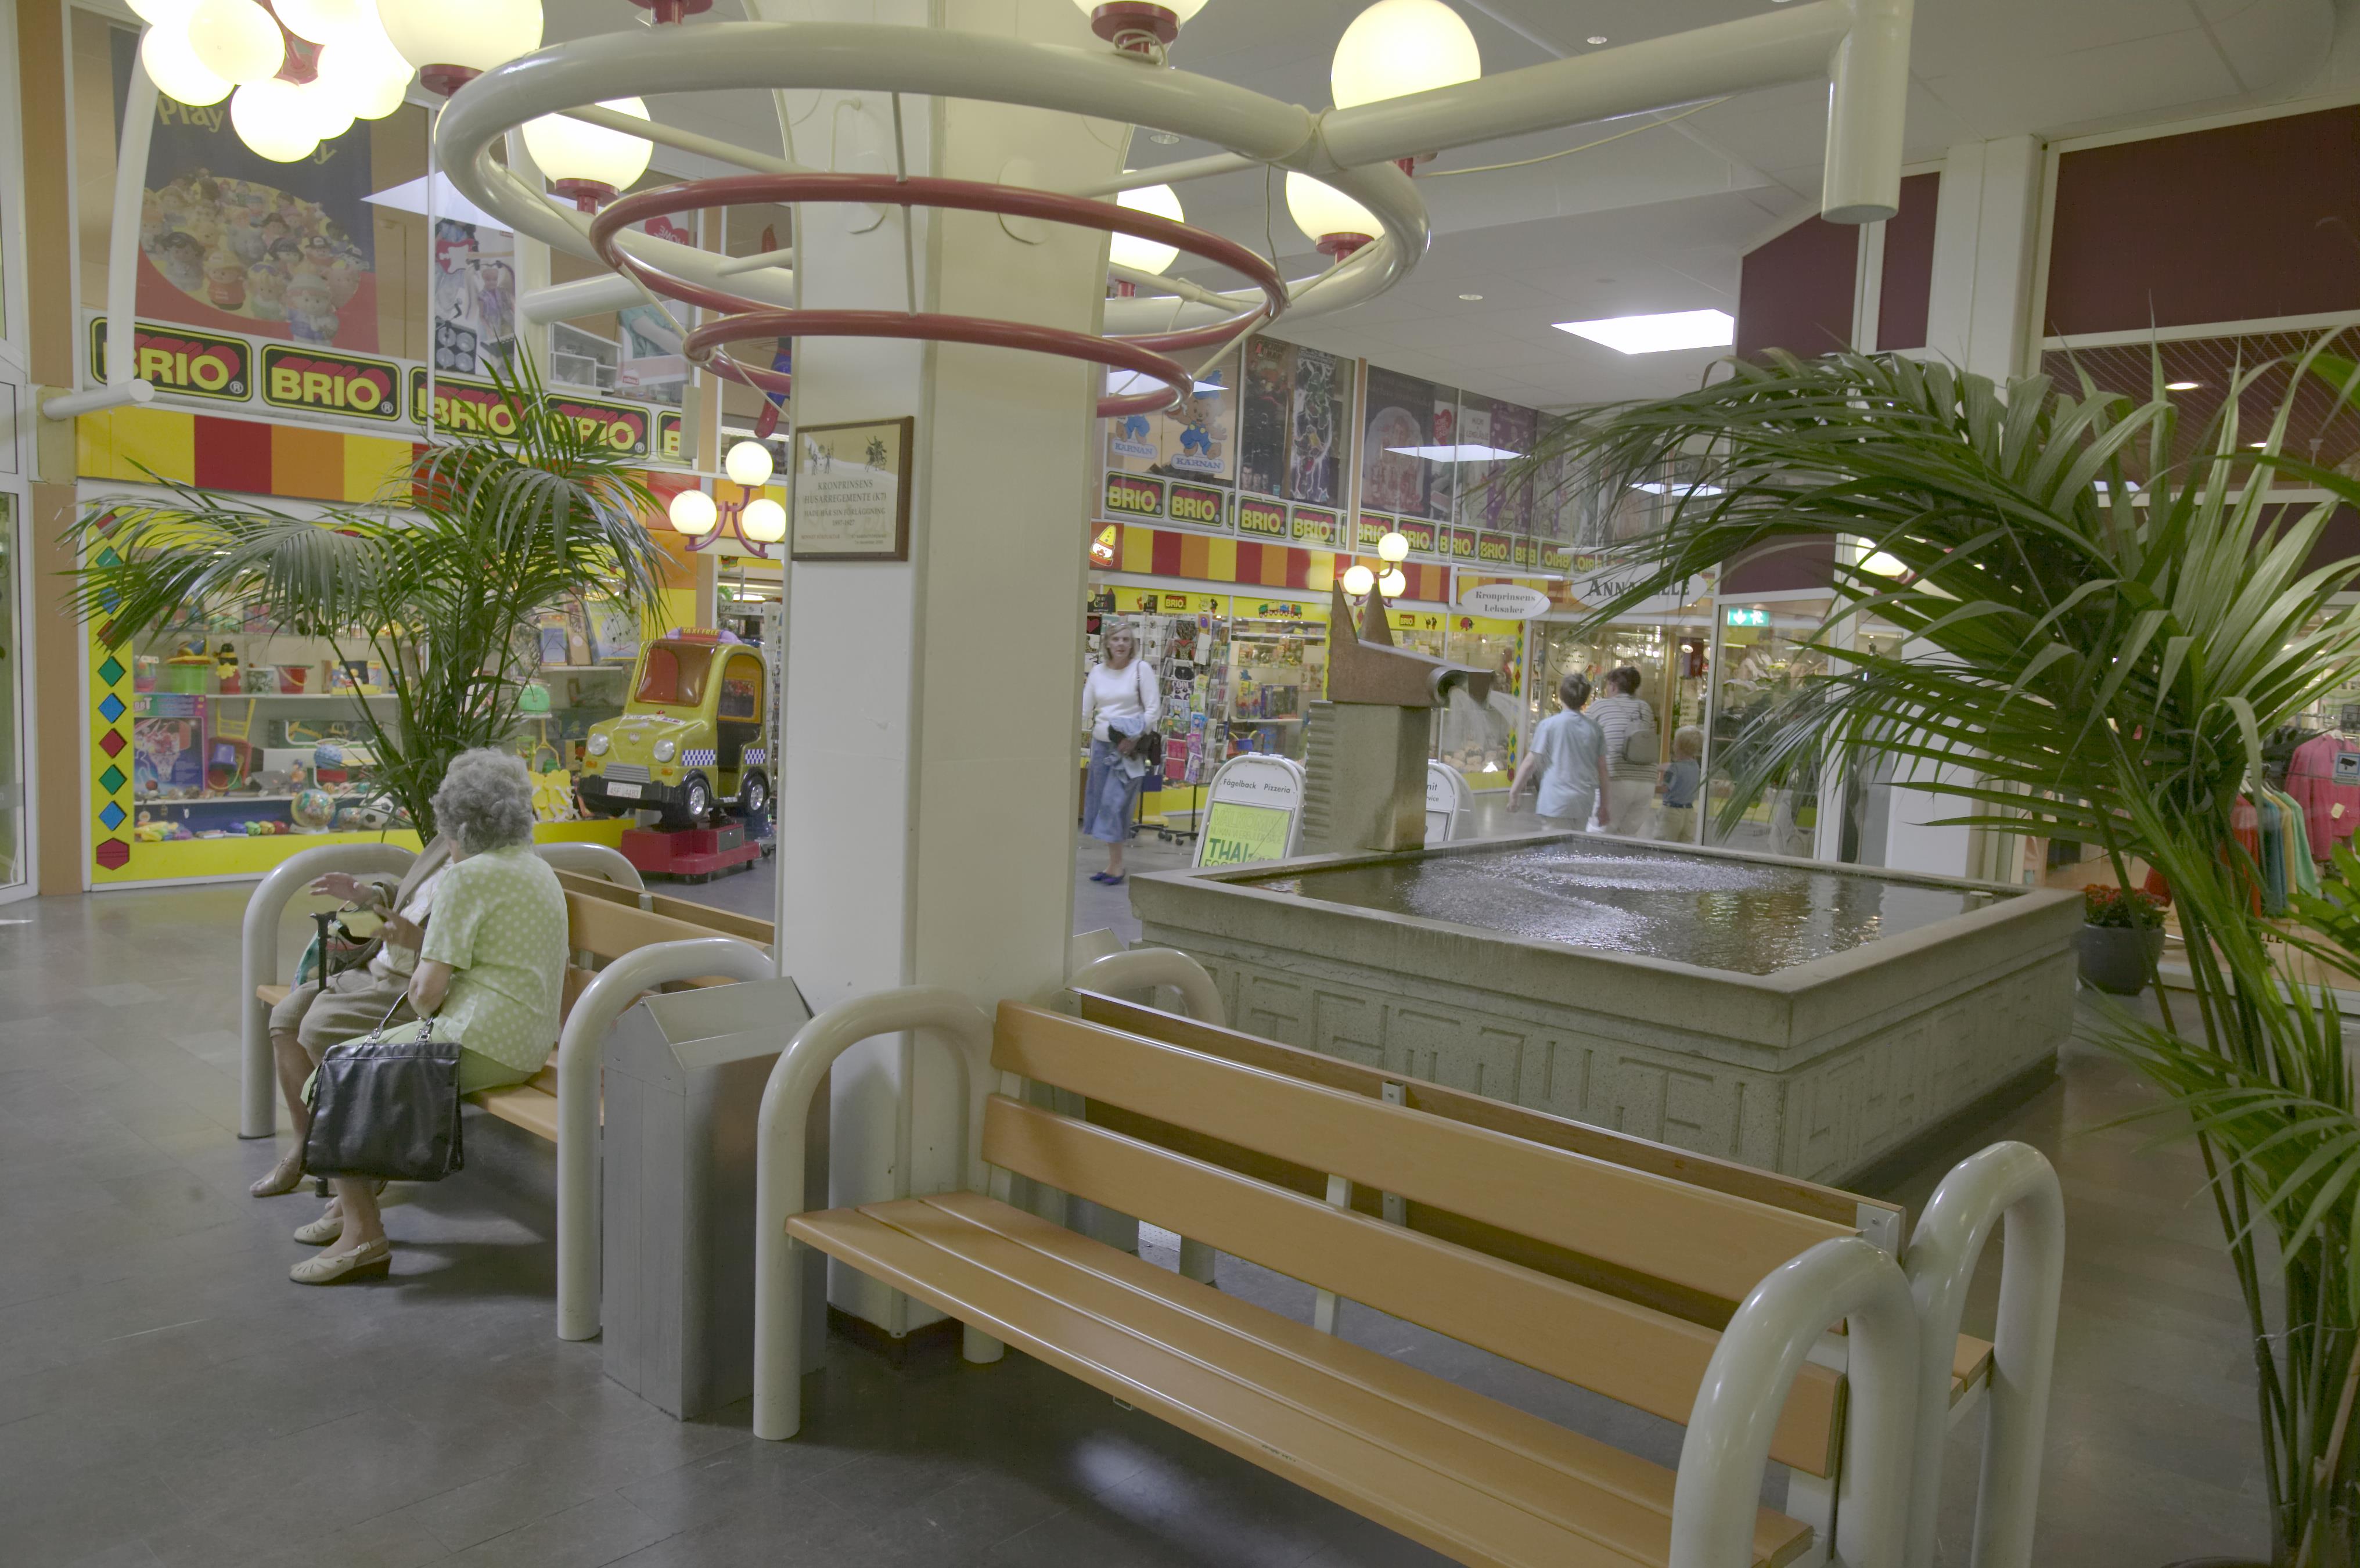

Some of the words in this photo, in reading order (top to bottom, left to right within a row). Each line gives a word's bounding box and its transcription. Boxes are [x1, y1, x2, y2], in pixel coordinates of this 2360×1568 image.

[157, 94, 224, 133] Play
[103, 341, 229, 390] RIO
[271, 366, 380, 411] BRIO
[418, 387, 516, 435] BRIO
[818, 479, 873, 491] KRONPRINSENS
[804, 493, 870, 504] HUSARREGEMENTE
[1108, 486, 1156, 512] BRIO
[1172, 499, 1215, 521] BRIO
[1242, 509, 1280, 533] BRIO
[1293, 518, 1330, 540] BRIO
[1440, 536, 1471, 555] BRIO
[1480, 542, 1506, 559] BRIO
[1165, 599, 1183, 607] BRIO
[1476, 591, 1536, 602] Kronprinsens
[1485, 605, 1524, 614] Leksaker
[1223, 779, 1257, 789] Fågelback
[1264, 783, 1290, 793] Pizzeria
